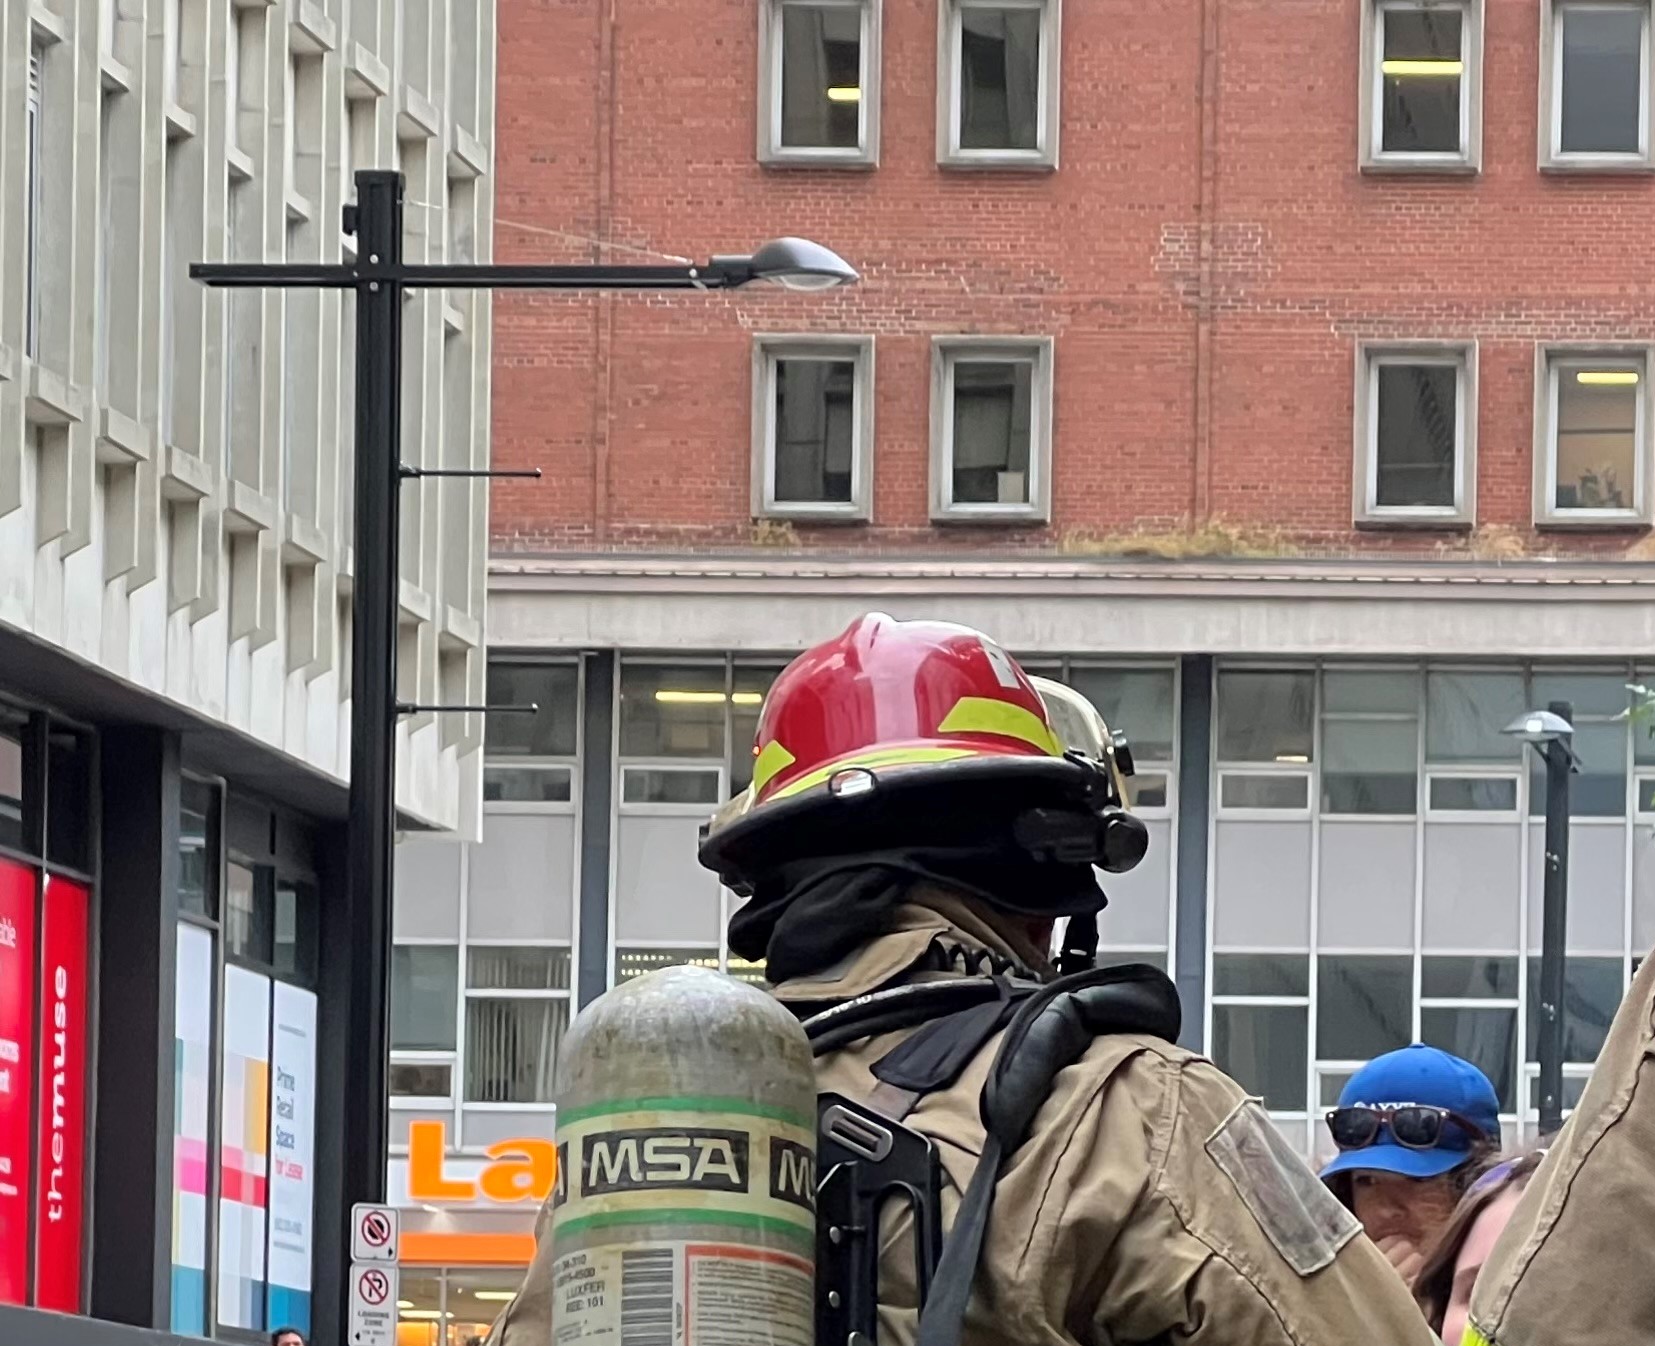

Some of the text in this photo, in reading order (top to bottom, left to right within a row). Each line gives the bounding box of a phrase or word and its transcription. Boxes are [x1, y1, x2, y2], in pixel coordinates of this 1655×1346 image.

[48, 965, 67, 1222] themuse
[410, 1121, 557, 1202] La
[588, 1137, 742, 1187] MSA
